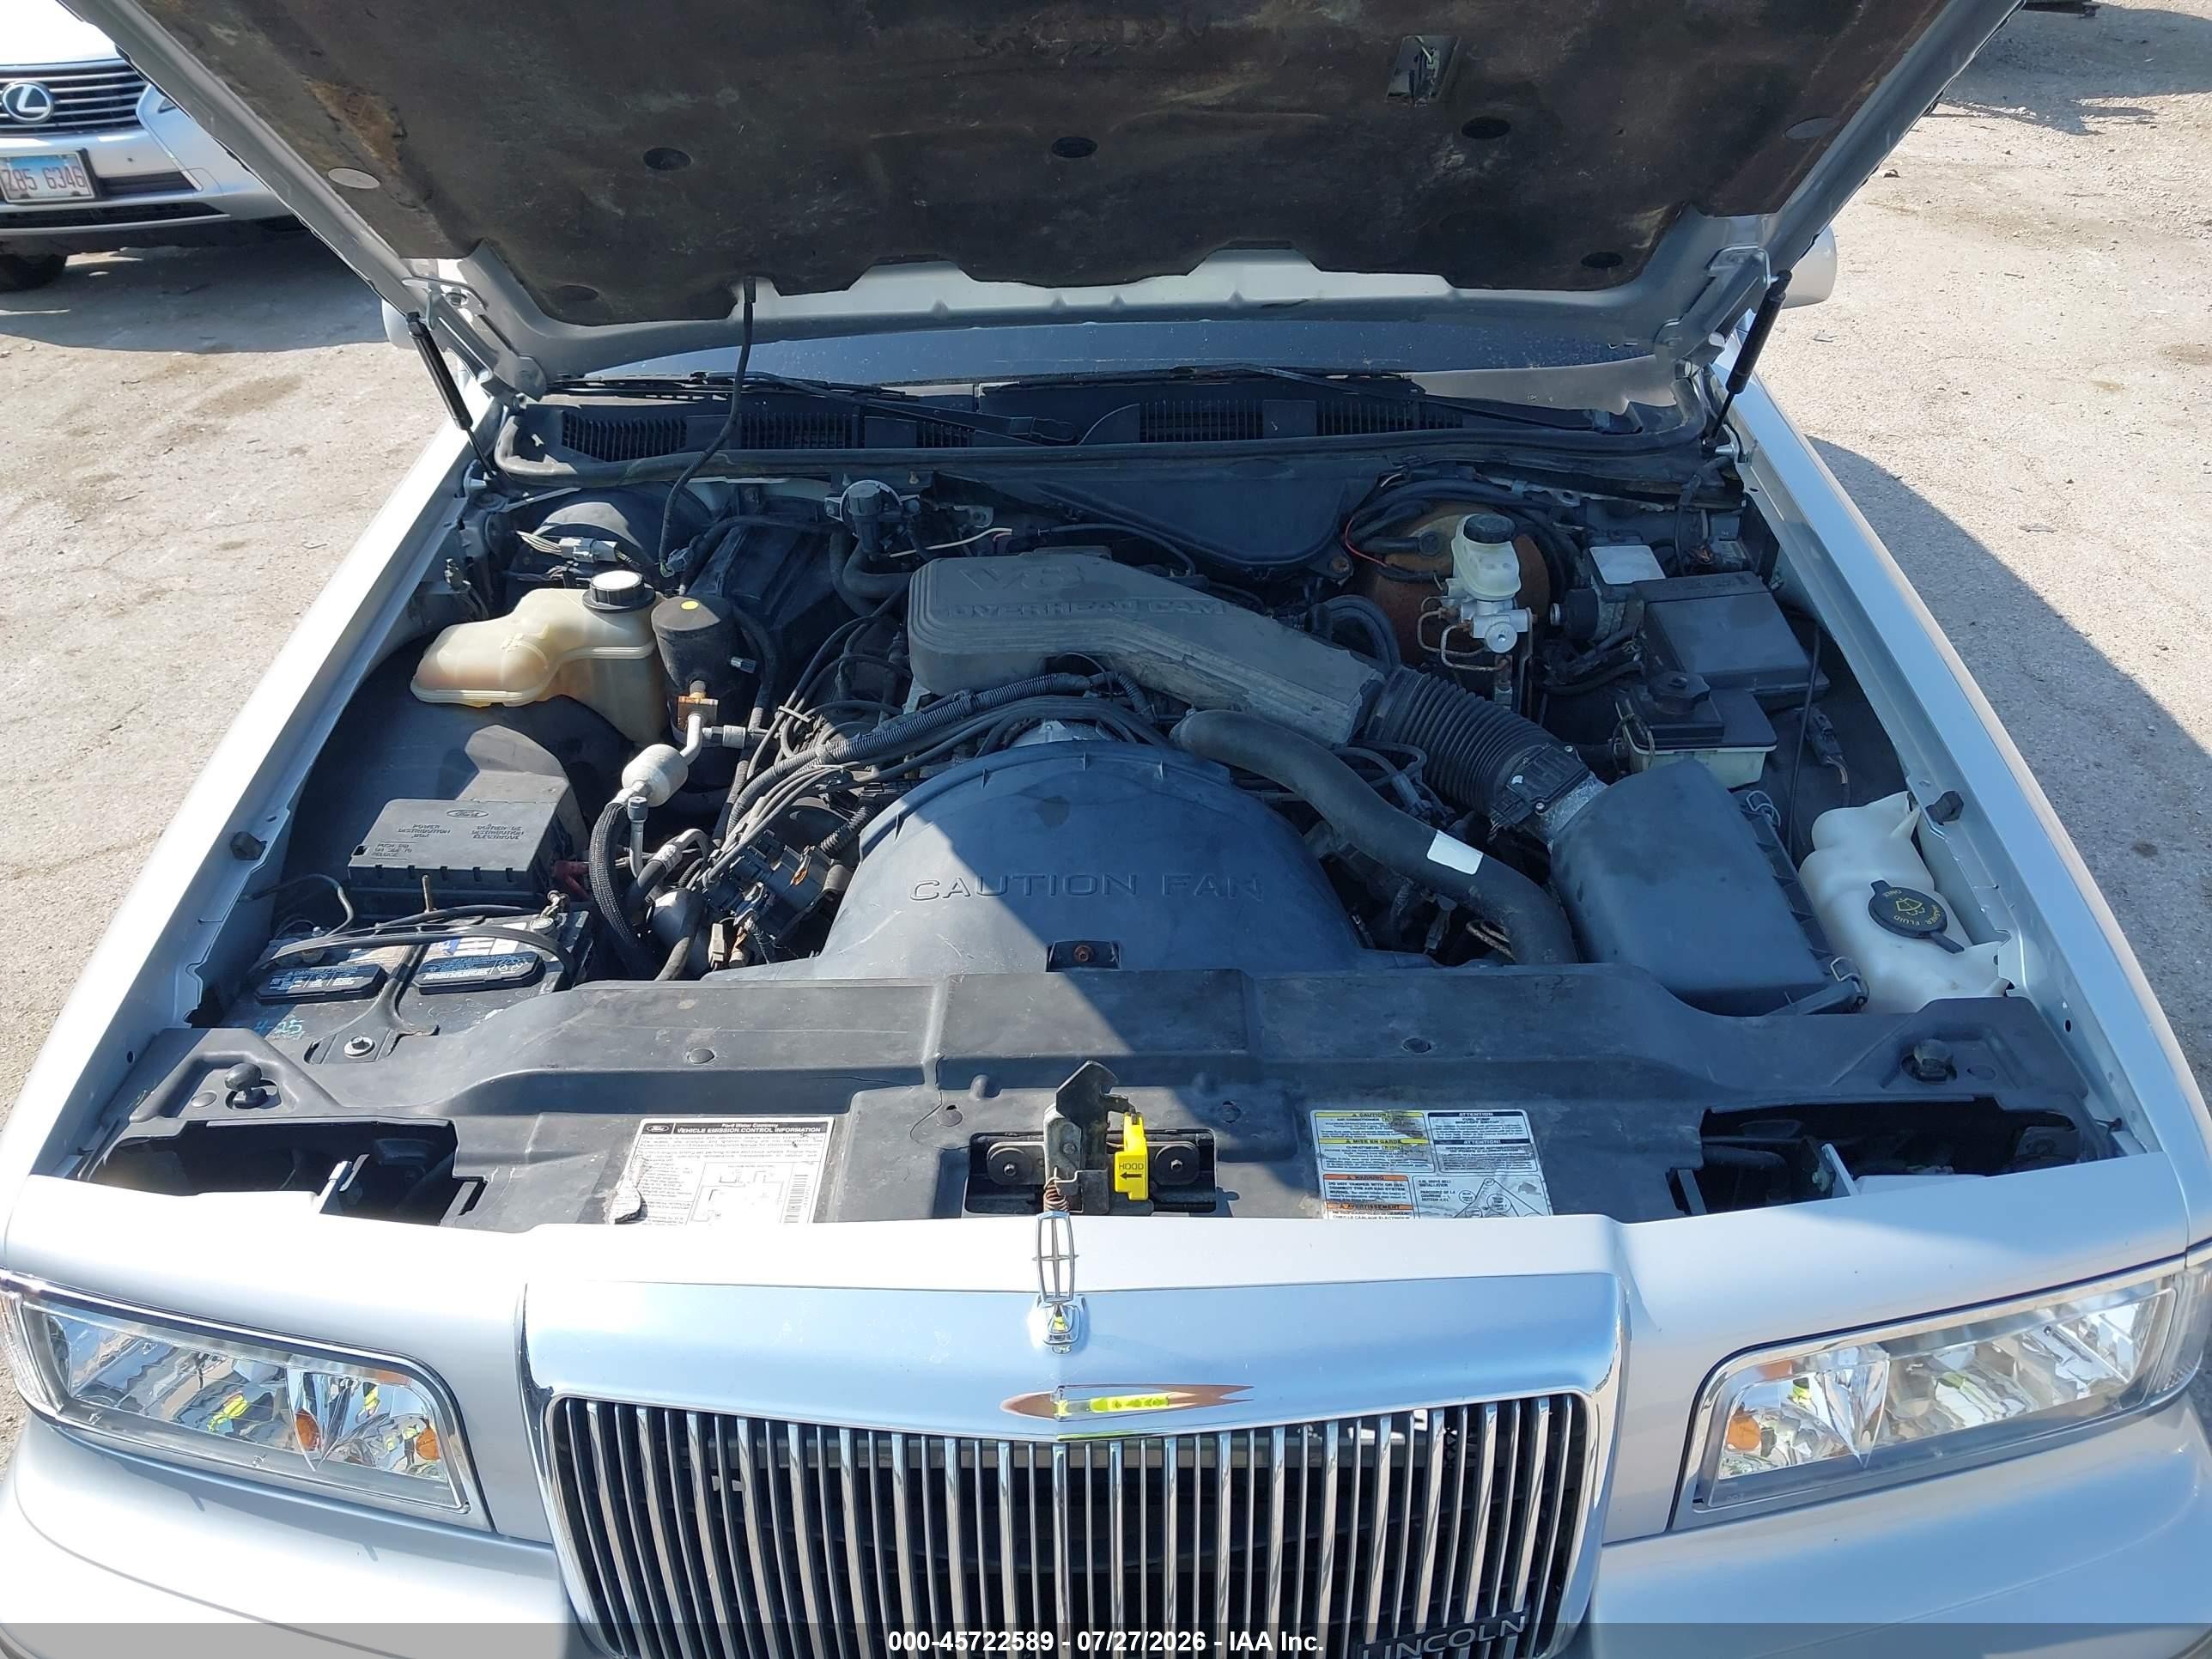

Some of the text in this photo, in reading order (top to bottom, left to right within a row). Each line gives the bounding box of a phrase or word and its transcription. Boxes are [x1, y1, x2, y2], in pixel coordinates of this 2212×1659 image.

[959, 564, 1085, 591] V8
[948, 599, 1226, 618] OVERHEAD CAM
[909, 872, 1265, 902] CAUTION FAN
[1893, 915, 1921, 927] FLUID
